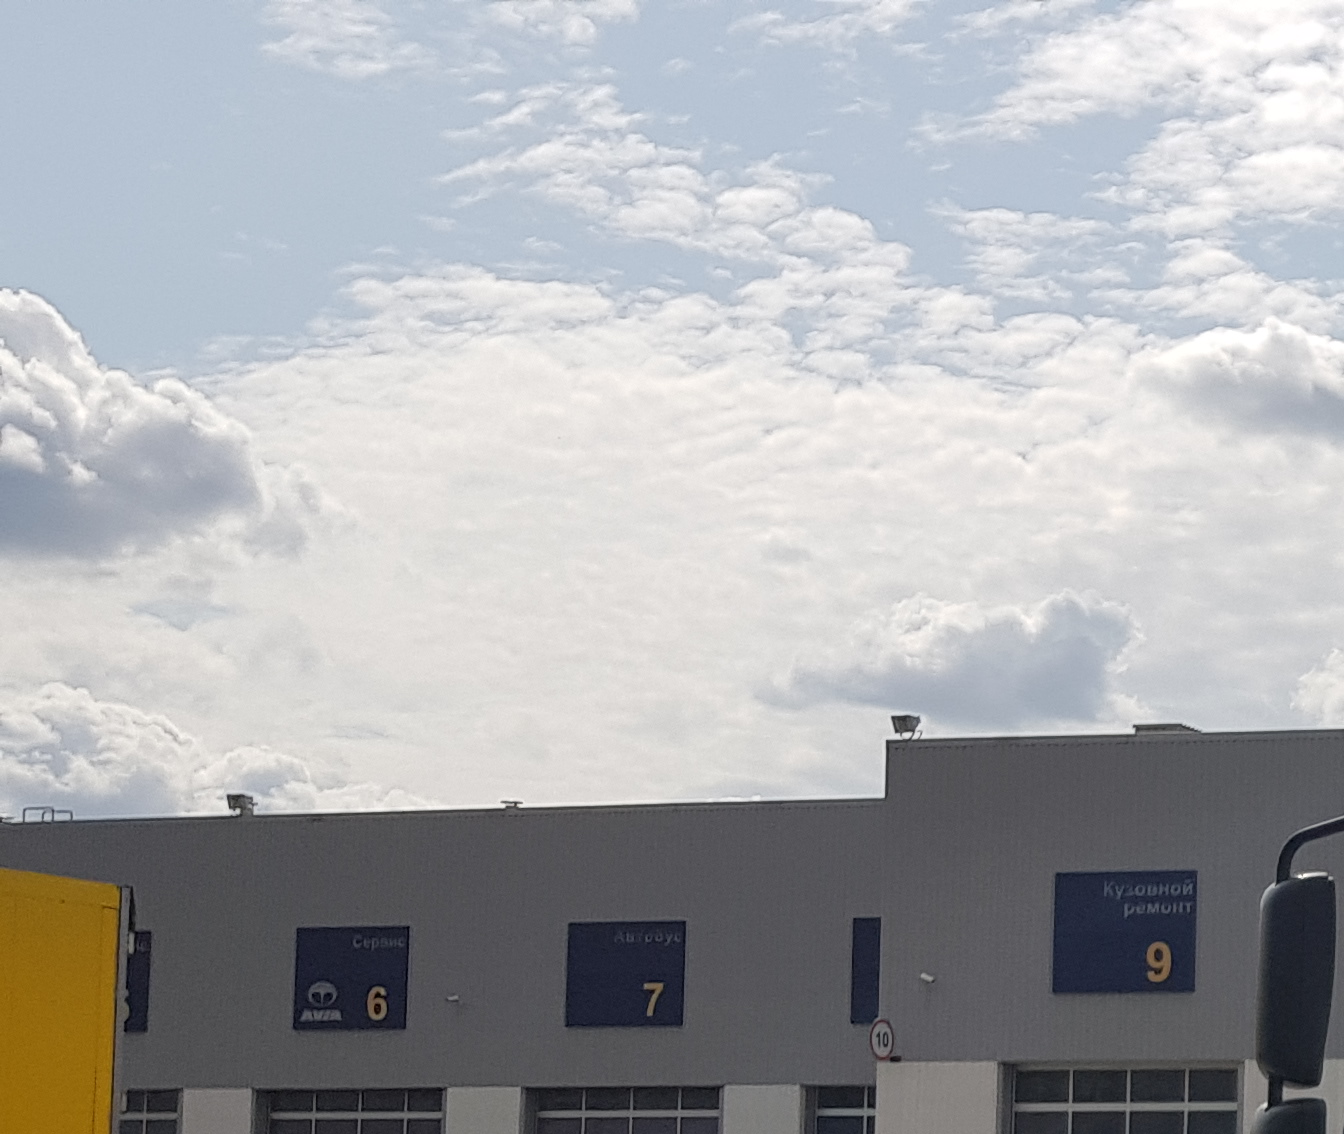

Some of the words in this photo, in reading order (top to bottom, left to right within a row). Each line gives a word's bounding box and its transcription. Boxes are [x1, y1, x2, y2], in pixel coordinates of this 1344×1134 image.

[1103, 878, 1195, 899] Кузовной
[1123, 902, 1192, 919] ремонт
[353, 935, 405, 951] Сервис
[1146, 941, 1172, 983] 9
[367, 985, 388, 1021] 6
[643, 982, 664, 1017] 7
[300, 1008, 342, 1021] AVIA
[876, 1031, 889, 1048] 10
